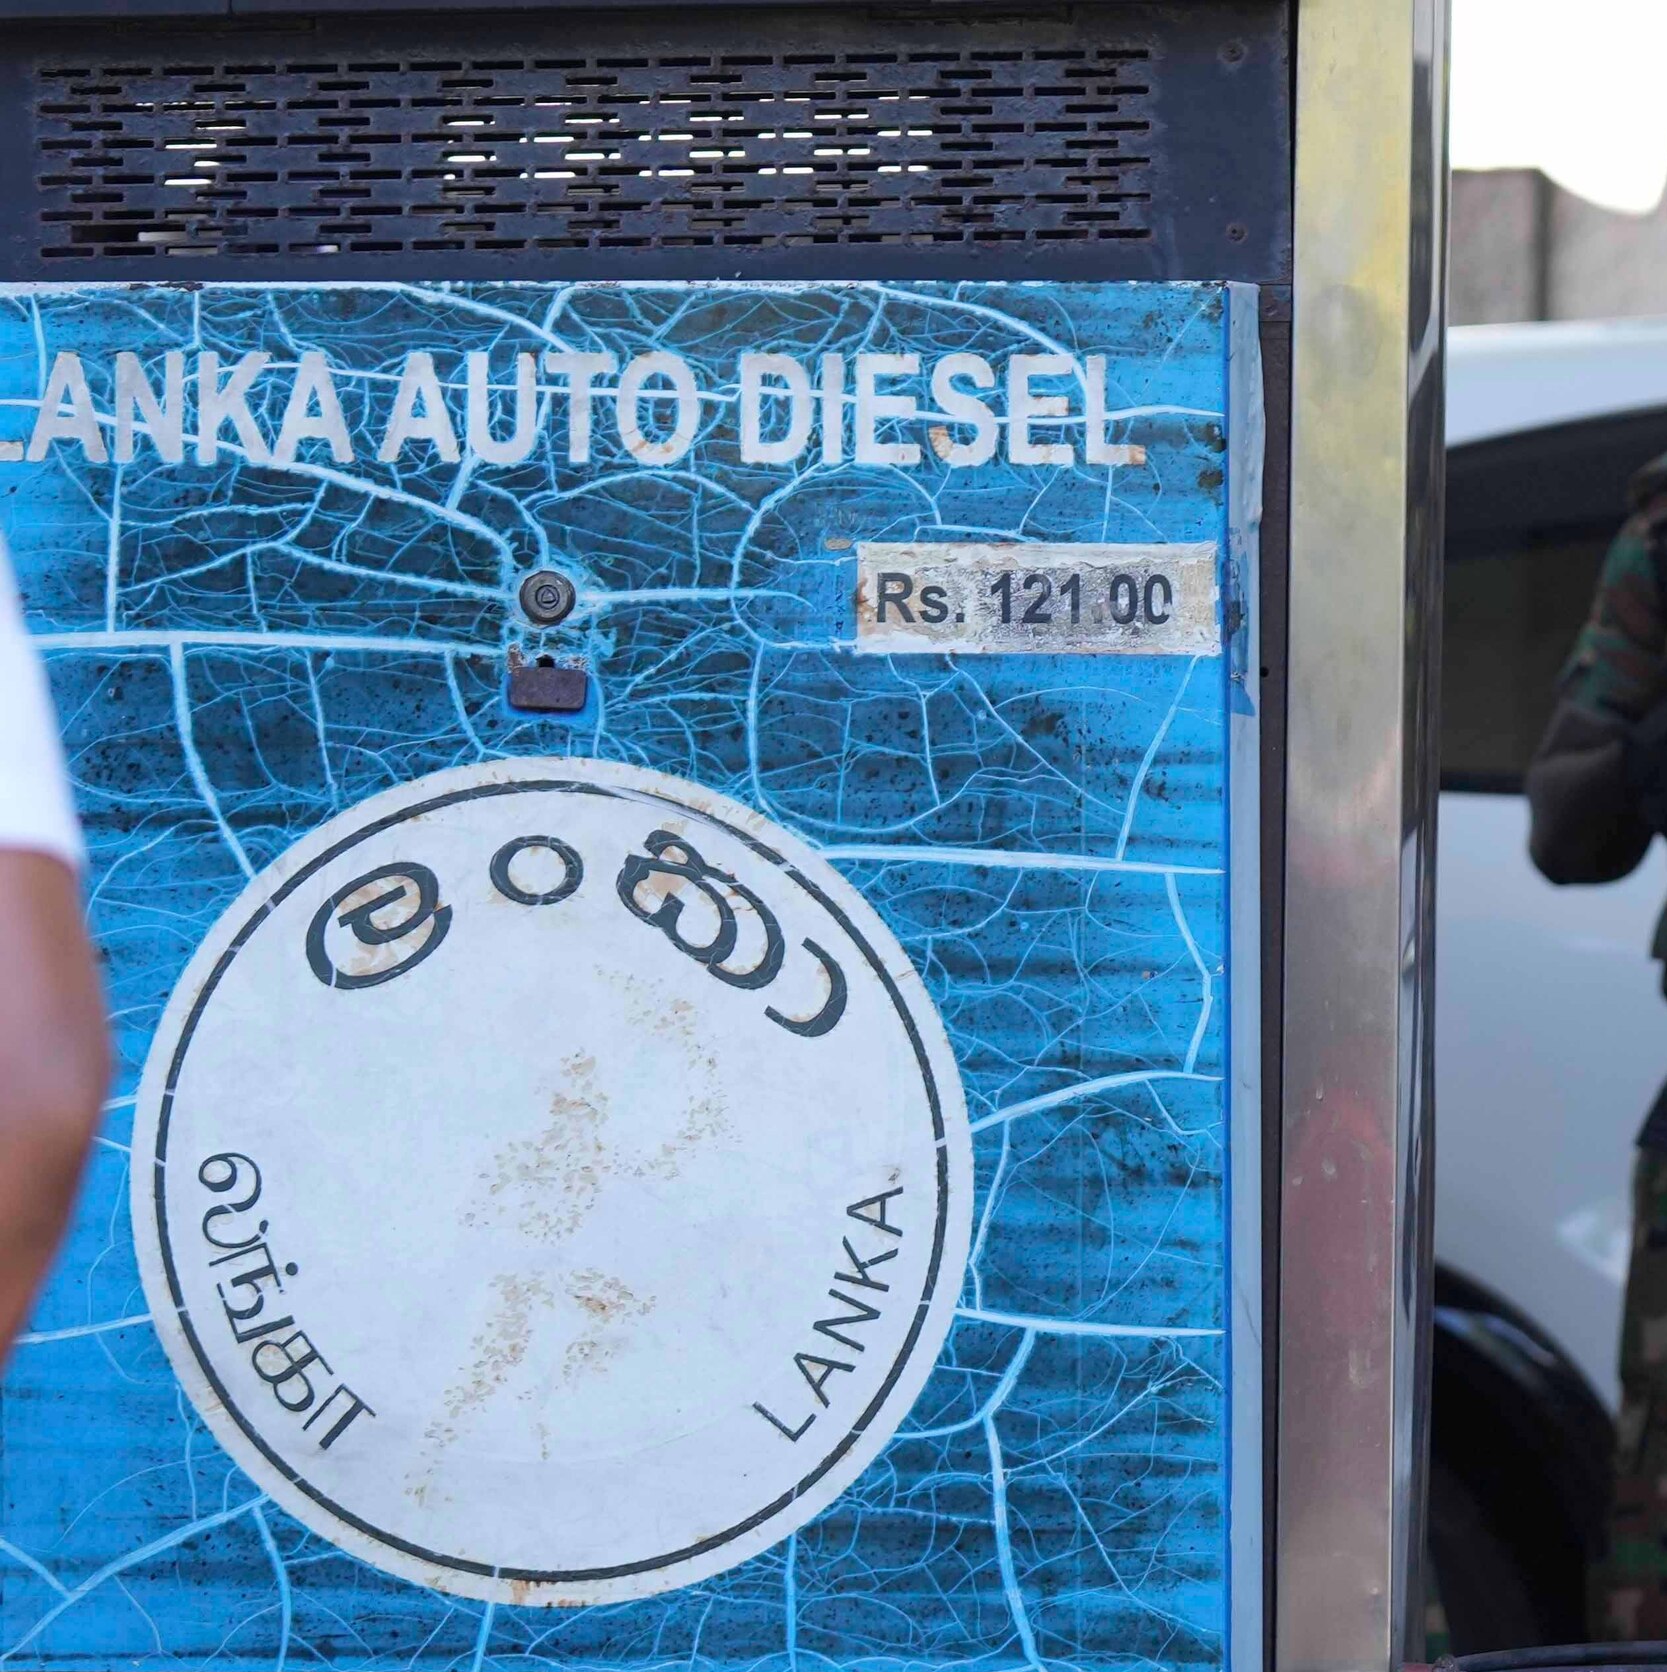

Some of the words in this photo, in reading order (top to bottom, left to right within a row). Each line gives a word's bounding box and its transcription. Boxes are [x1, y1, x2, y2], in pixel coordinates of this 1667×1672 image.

[0, 351, 354, 464] ANKA
[378, 351, 702, 466] AUTO
[739, 352, 1148, 468] DIESEL
[877, 572, 965, 623] Rs.
[304, 829, 848, 1038] ලංකා
[198, 1152, 377, 1451] லங்கா
[753, 1187, 904, 1443] LANKA
